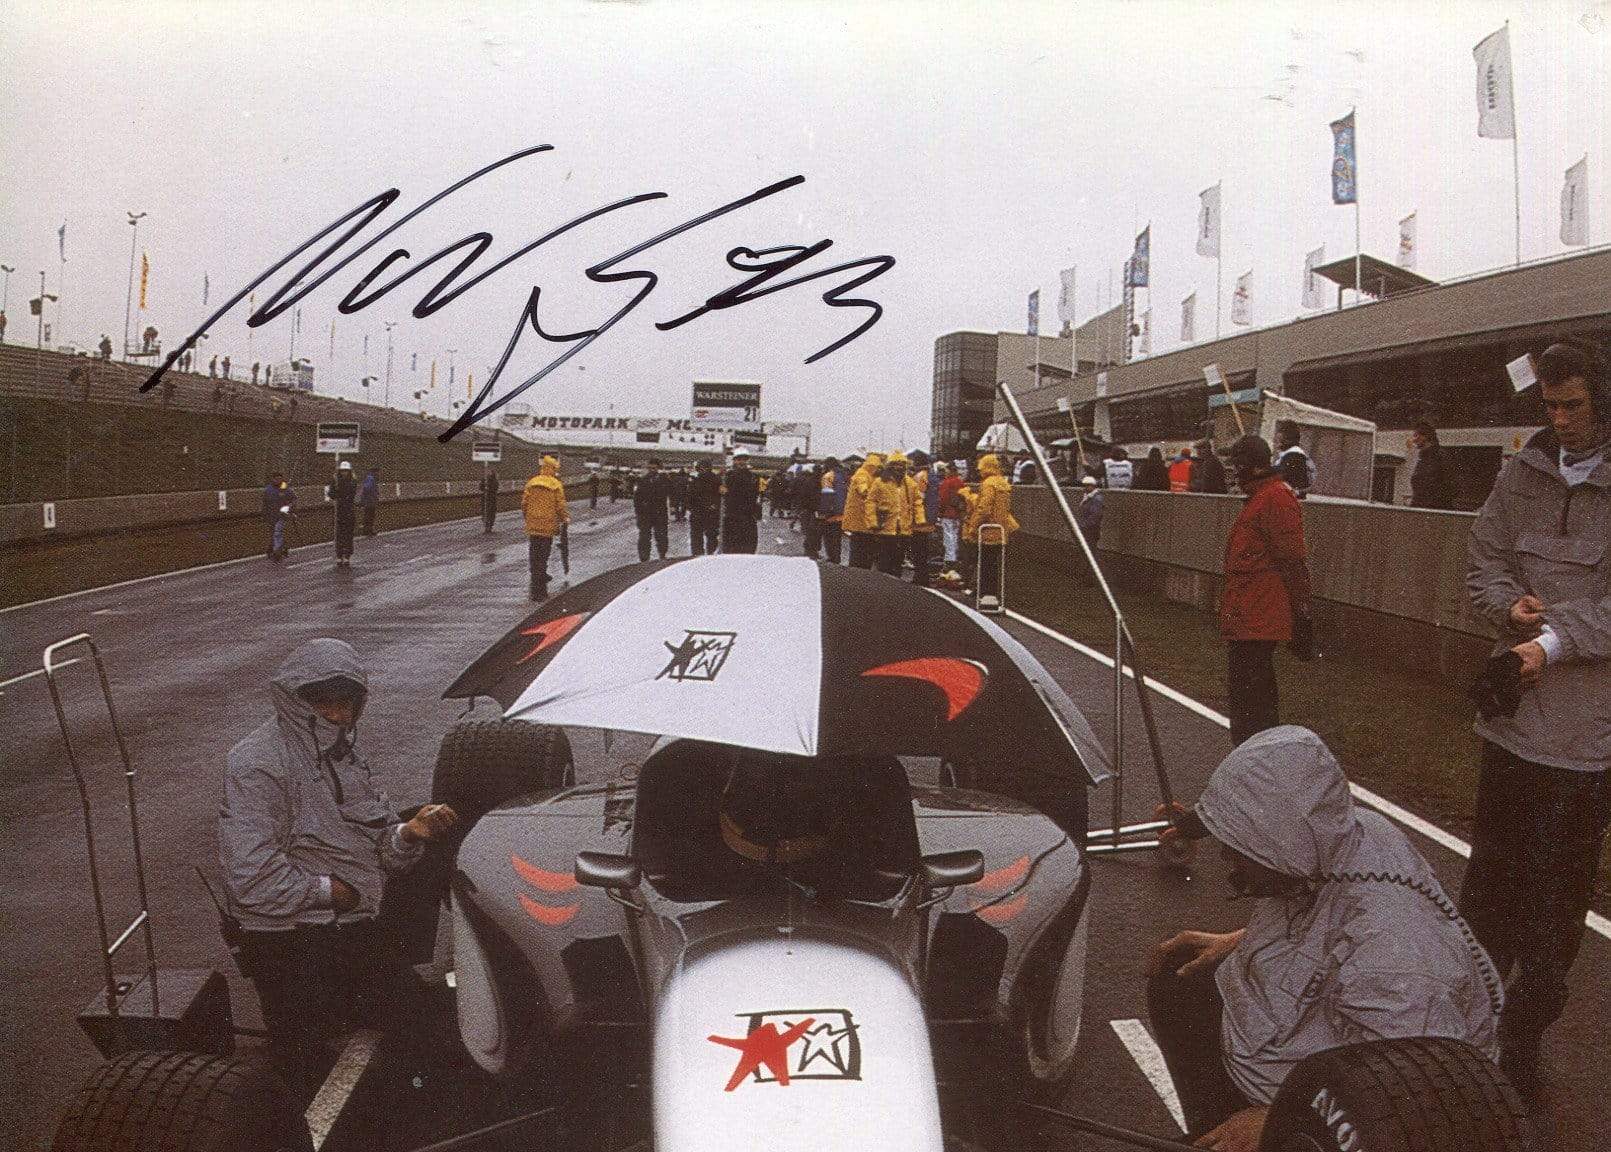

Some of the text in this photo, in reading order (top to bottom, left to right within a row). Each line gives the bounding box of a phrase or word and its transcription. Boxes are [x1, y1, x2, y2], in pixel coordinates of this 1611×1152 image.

[697, 390, 758, 401] WARSTEINER
[743, 406, 757, 421] 21
[532, 417, 630, 429] MOTOPARK
